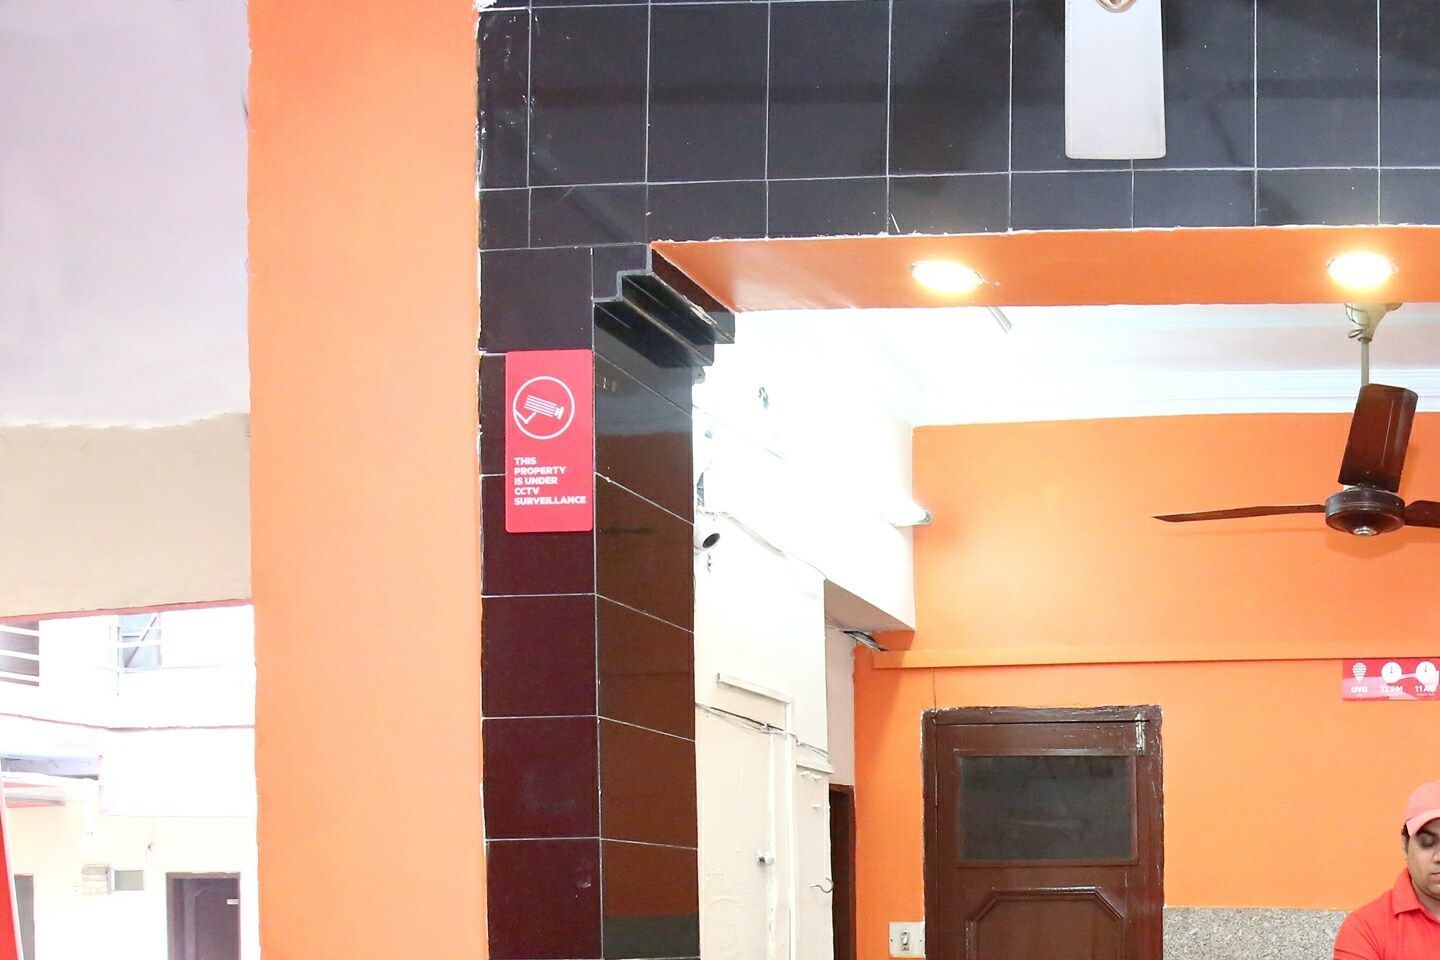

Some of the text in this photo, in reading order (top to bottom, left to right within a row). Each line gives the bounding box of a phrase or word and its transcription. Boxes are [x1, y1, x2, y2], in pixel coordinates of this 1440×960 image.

[514, 457, 537, 465] THIS
[514, 466, 566, 475] PROPERTY
[514, 475, 558, 485] IS UNDER
[514, 487, 540, 495] CCTV
[514, 496, 586, 505] SURVEILLANCE
[1350, 685, 1369, 694] OYO
[1414, 684, 1423, 693] 11
